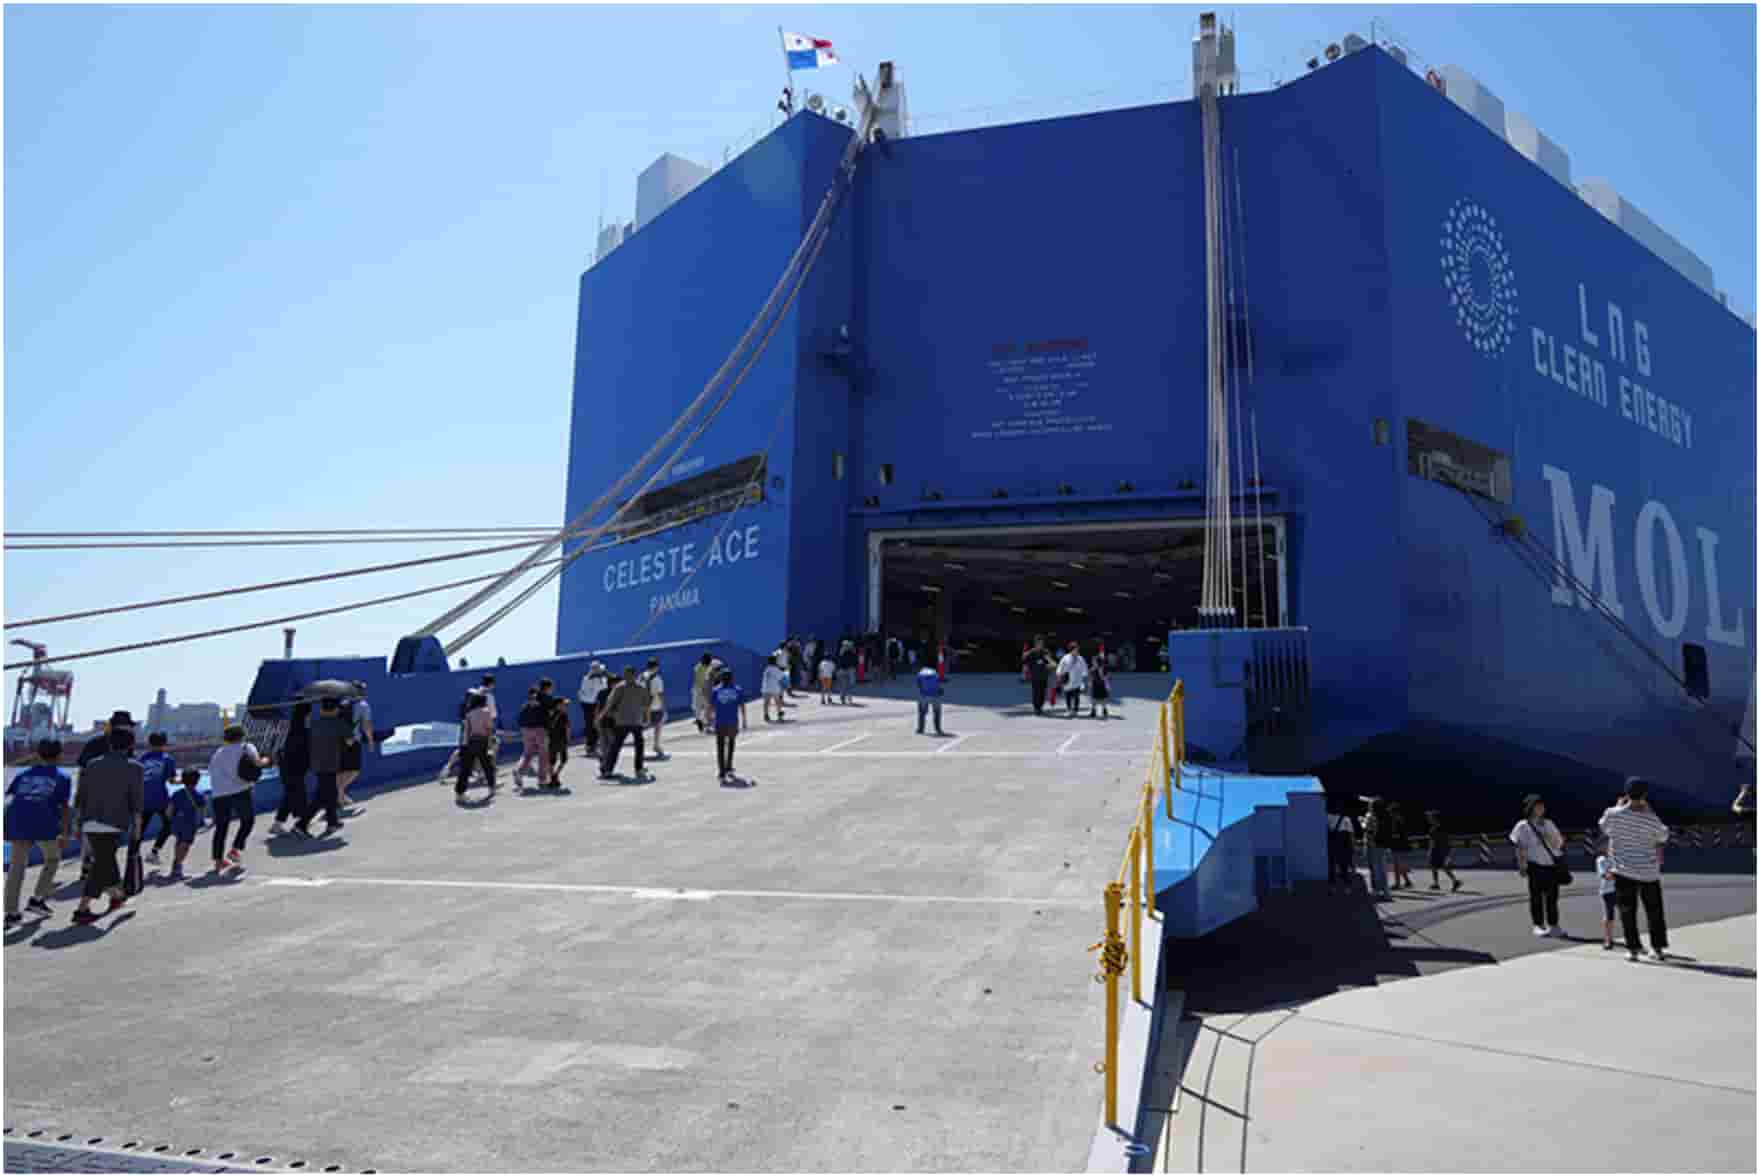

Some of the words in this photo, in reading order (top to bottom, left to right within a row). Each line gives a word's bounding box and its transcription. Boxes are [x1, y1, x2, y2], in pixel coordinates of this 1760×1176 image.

[1579, 281, 1651, 378] LNG
[1532, 327, 1608, 409] CLEAN
[1619, 375, 1693, 450] ENERGY
[603, 543, 697, 593] CELESTE
[707, 524, 761, 567] ACE
[1543, 463, 1745, 647] MOL
